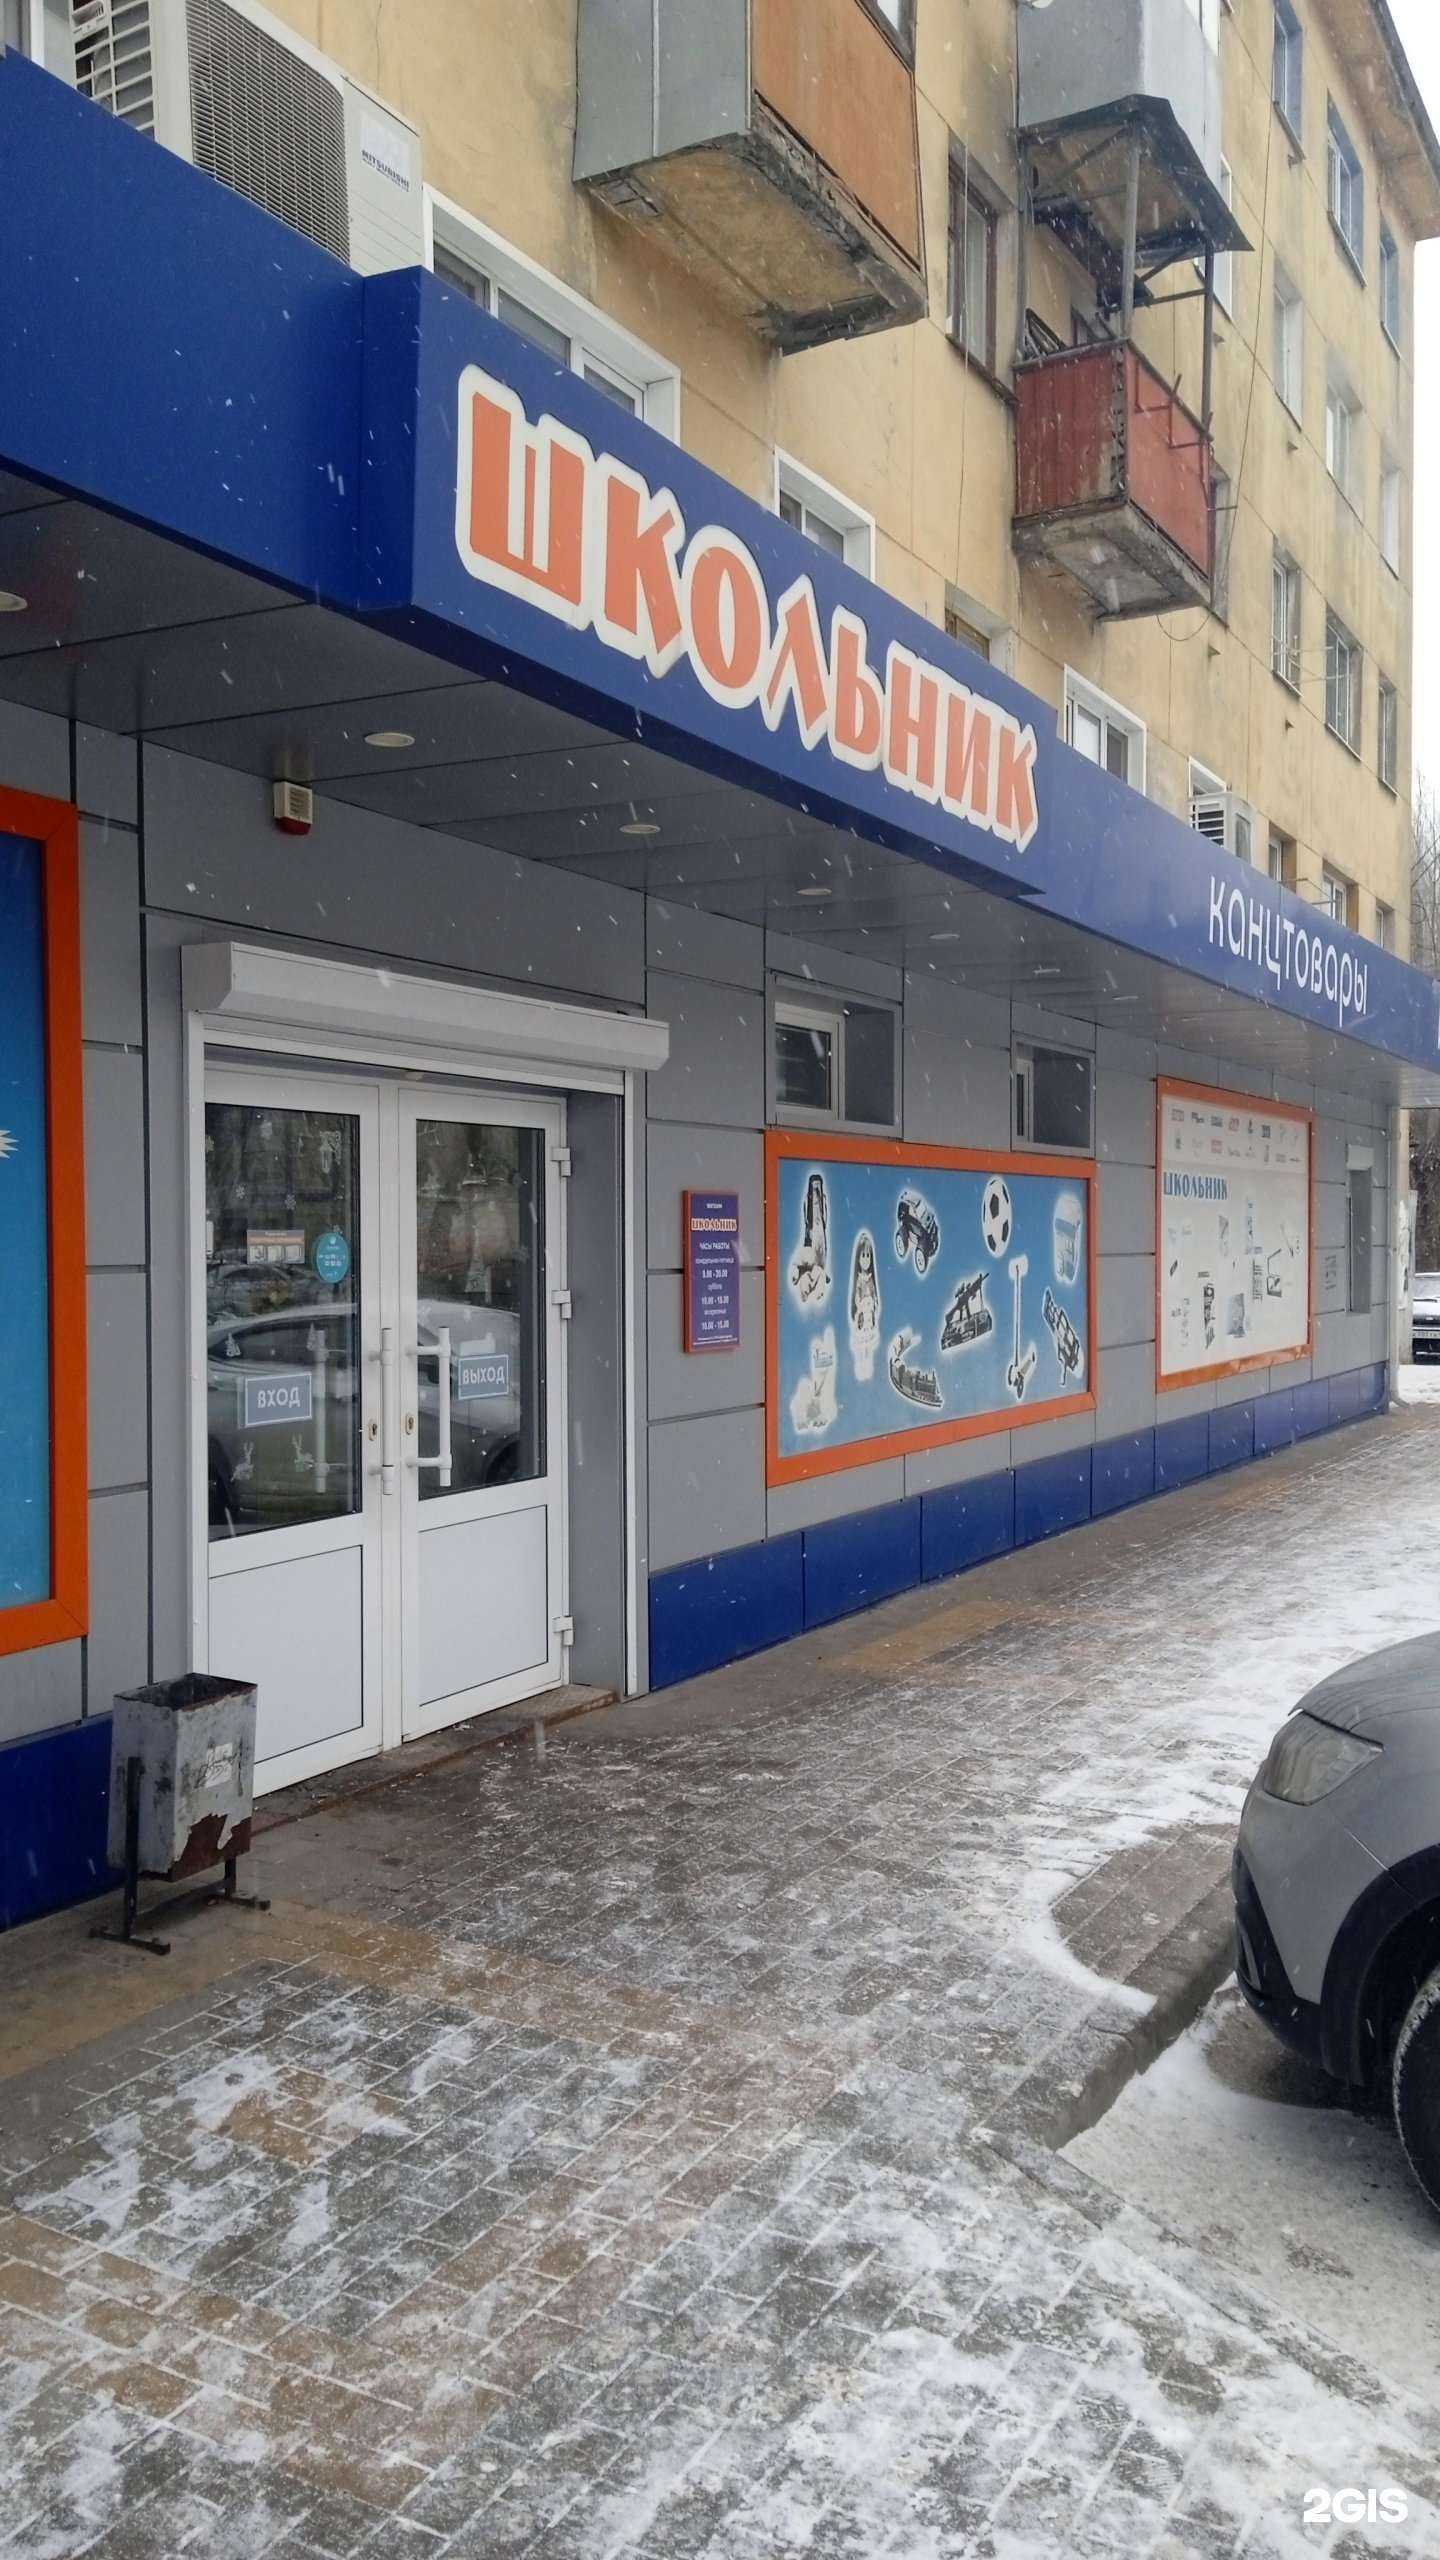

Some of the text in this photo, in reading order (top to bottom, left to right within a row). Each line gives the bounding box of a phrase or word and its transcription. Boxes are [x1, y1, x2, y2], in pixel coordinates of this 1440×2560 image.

[456, 364, 1038, 852] ШКОЛЬНИК
[1163, 1171, 1228, 1200] ШКОЛЬНИК
[691, 1218, 737, 1231] ШКОЛЬНИК
[462, 1366, 505, 1385] ВЫХОД
[257, 1386, 301, 1409] ВХОД
